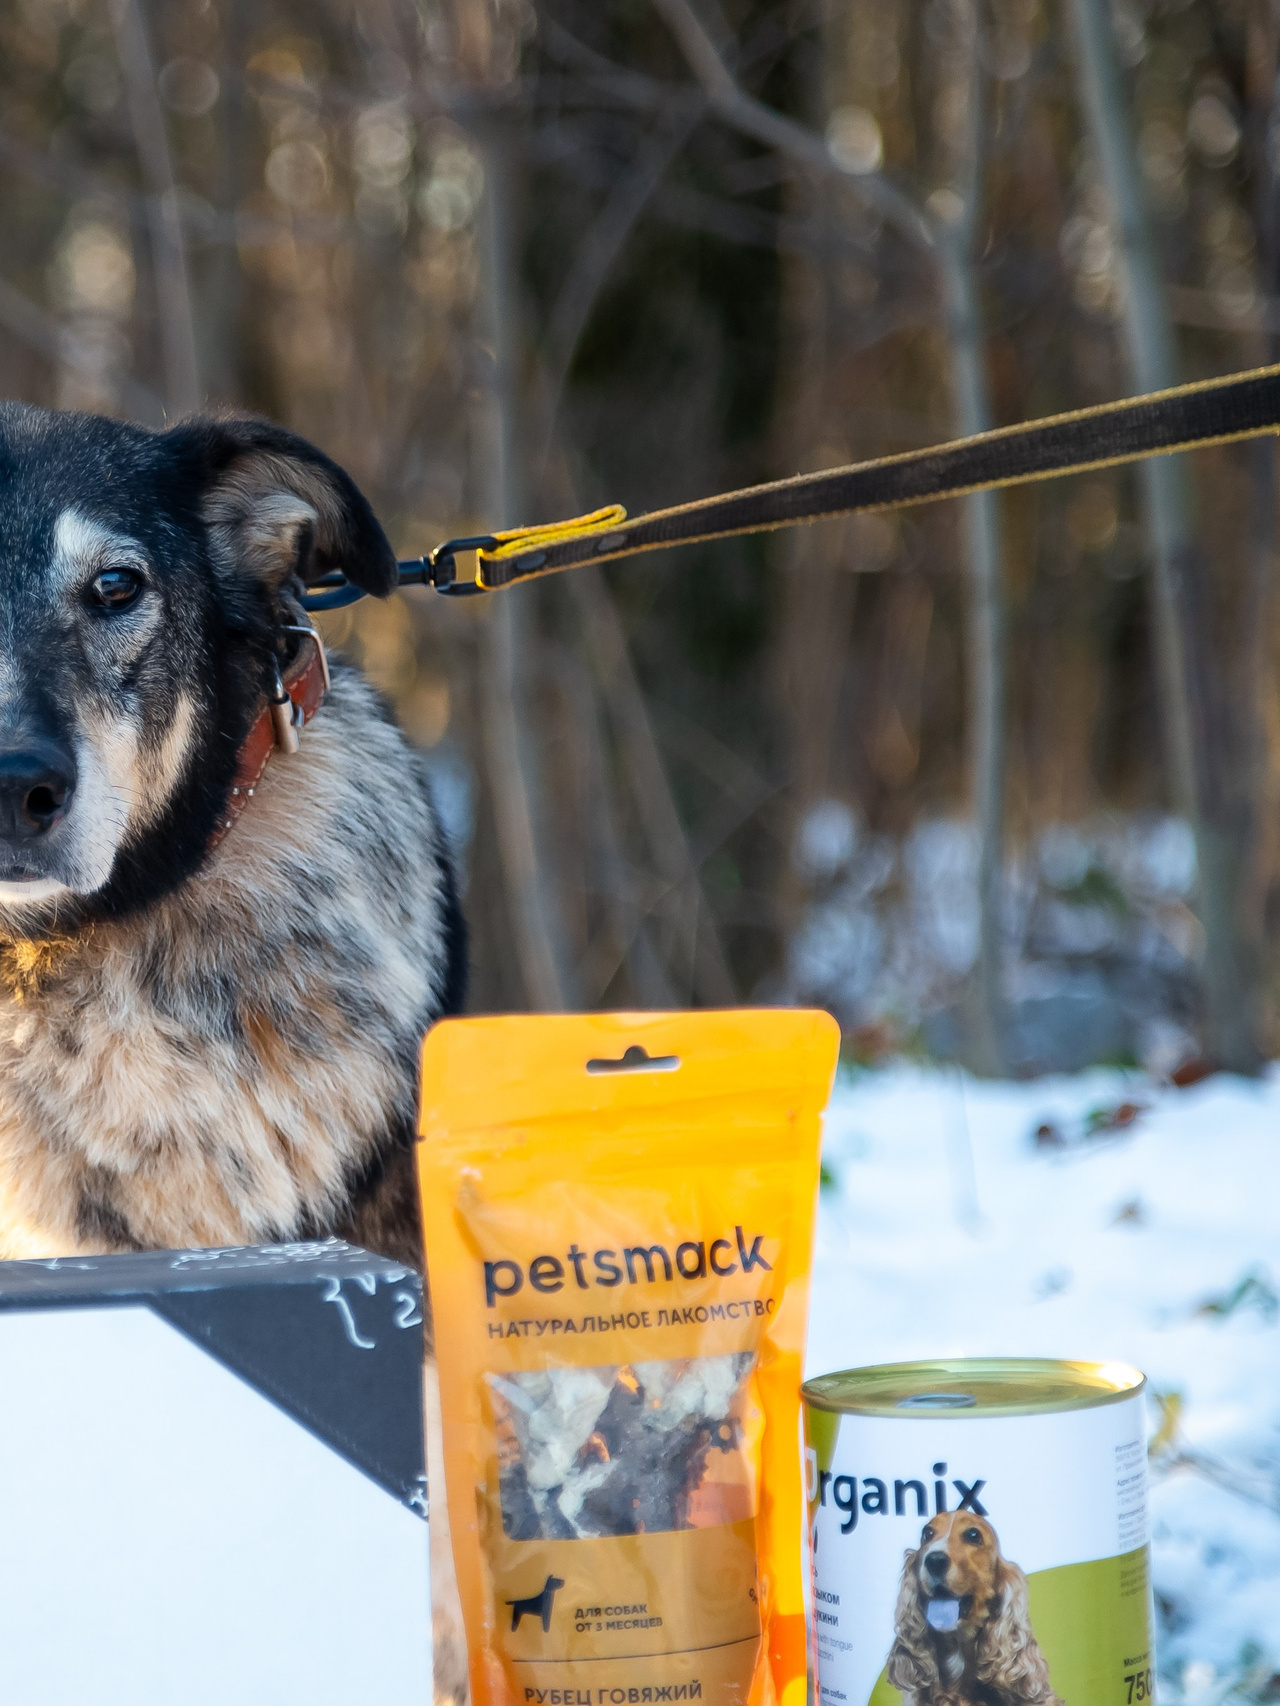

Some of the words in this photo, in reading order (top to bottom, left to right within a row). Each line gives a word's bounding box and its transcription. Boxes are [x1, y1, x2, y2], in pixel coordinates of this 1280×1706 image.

[483, 1226, 774, 1308] petsmack
[488, 1310, 652, 1339] НАТУРАЛЬНОЕ
[657, 1298, 776, 1326] ЛАКОМСТВО
[575, 1607, 602, 1619] ДЛЯ
[604, 1604, 648, 1616] СОБАК
[575, 1622, 593, 1632] ОТ
[596, 1622, 603, 1632] 3
[606, 1616, 663, 1631] МЕСЯЦЕВ
[830, 1637, 853, 1652] tongue
[524, 1687, 592, 1706] РУБЕЦ
[599, 1679, 703, 1704] ГОВЯЖИЙ
[830, 1690, 848, 1701] собак
